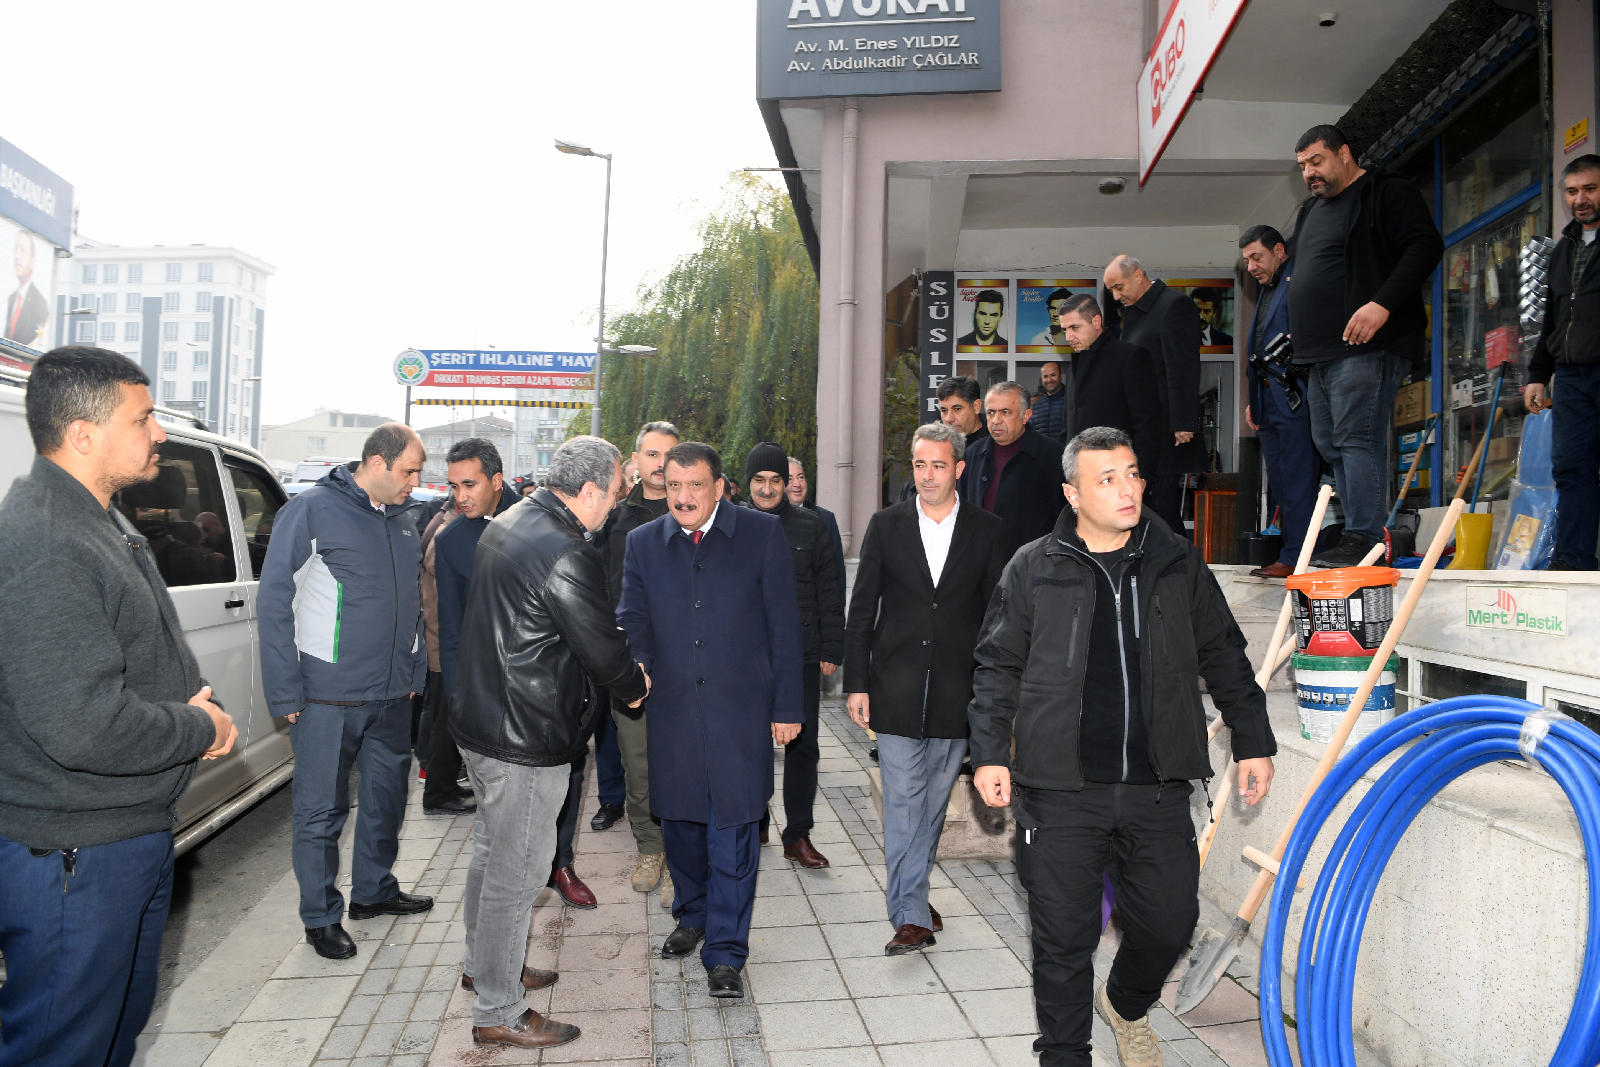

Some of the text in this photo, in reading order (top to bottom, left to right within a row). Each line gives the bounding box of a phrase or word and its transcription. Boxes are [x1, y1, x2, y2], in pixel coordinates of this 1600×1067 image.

[794, 35, 960, 53] Av. M. Enes YILDIZ
[787, 52, 979, 72] Av. Abdulkadir ÇAĞLAR
[430, 352, 476, 366] ŞERİT
[480, 353, 554, 367] İHLALİNE
[1468, 609, 1563, 631] Mert Plastik
